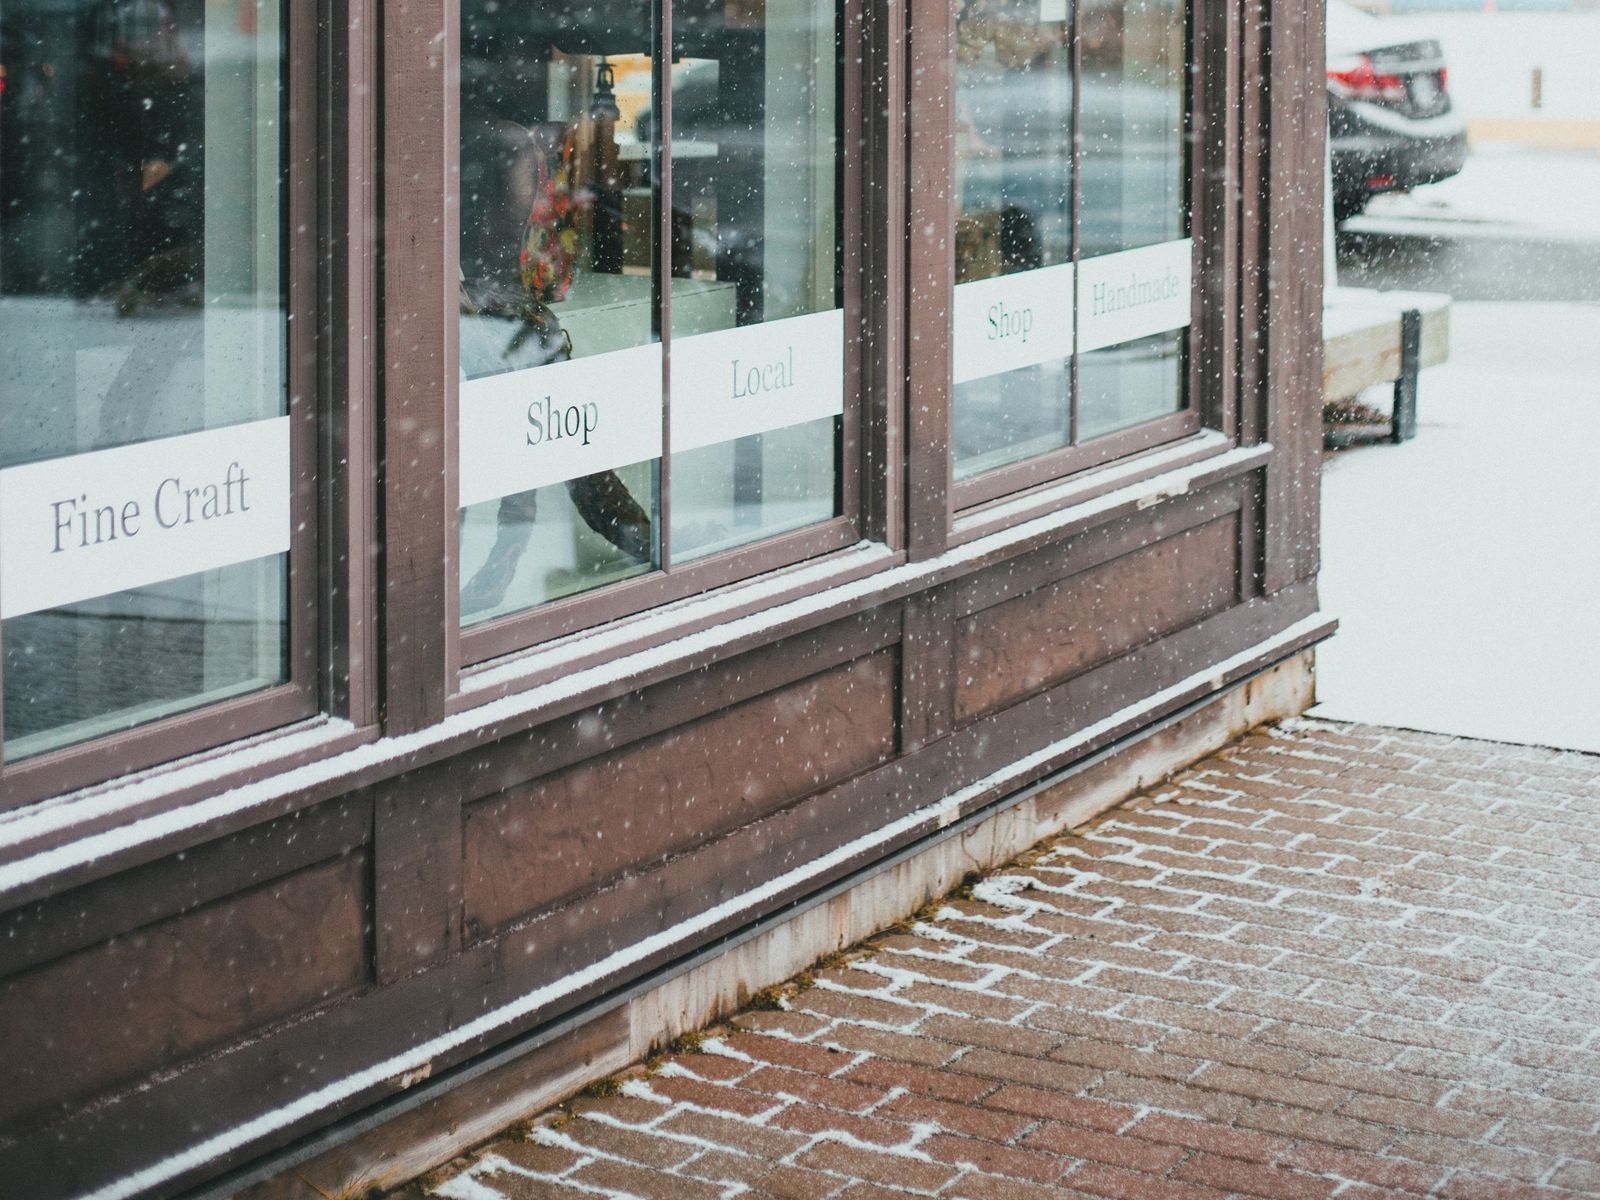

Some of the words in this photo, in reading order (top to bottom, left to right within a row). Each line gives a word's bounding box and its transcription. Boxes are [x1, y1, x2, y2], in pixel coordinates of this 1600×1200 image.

[988, 300, 1034, 343] Shop
[1092, 264, 1180, 317] Handmade
[526, 394, 599, 447] Shop
[730, 346, 794, 399] Local
[50, 493, 141, 554] Fine
[154, 461, 250, 530] Craft
